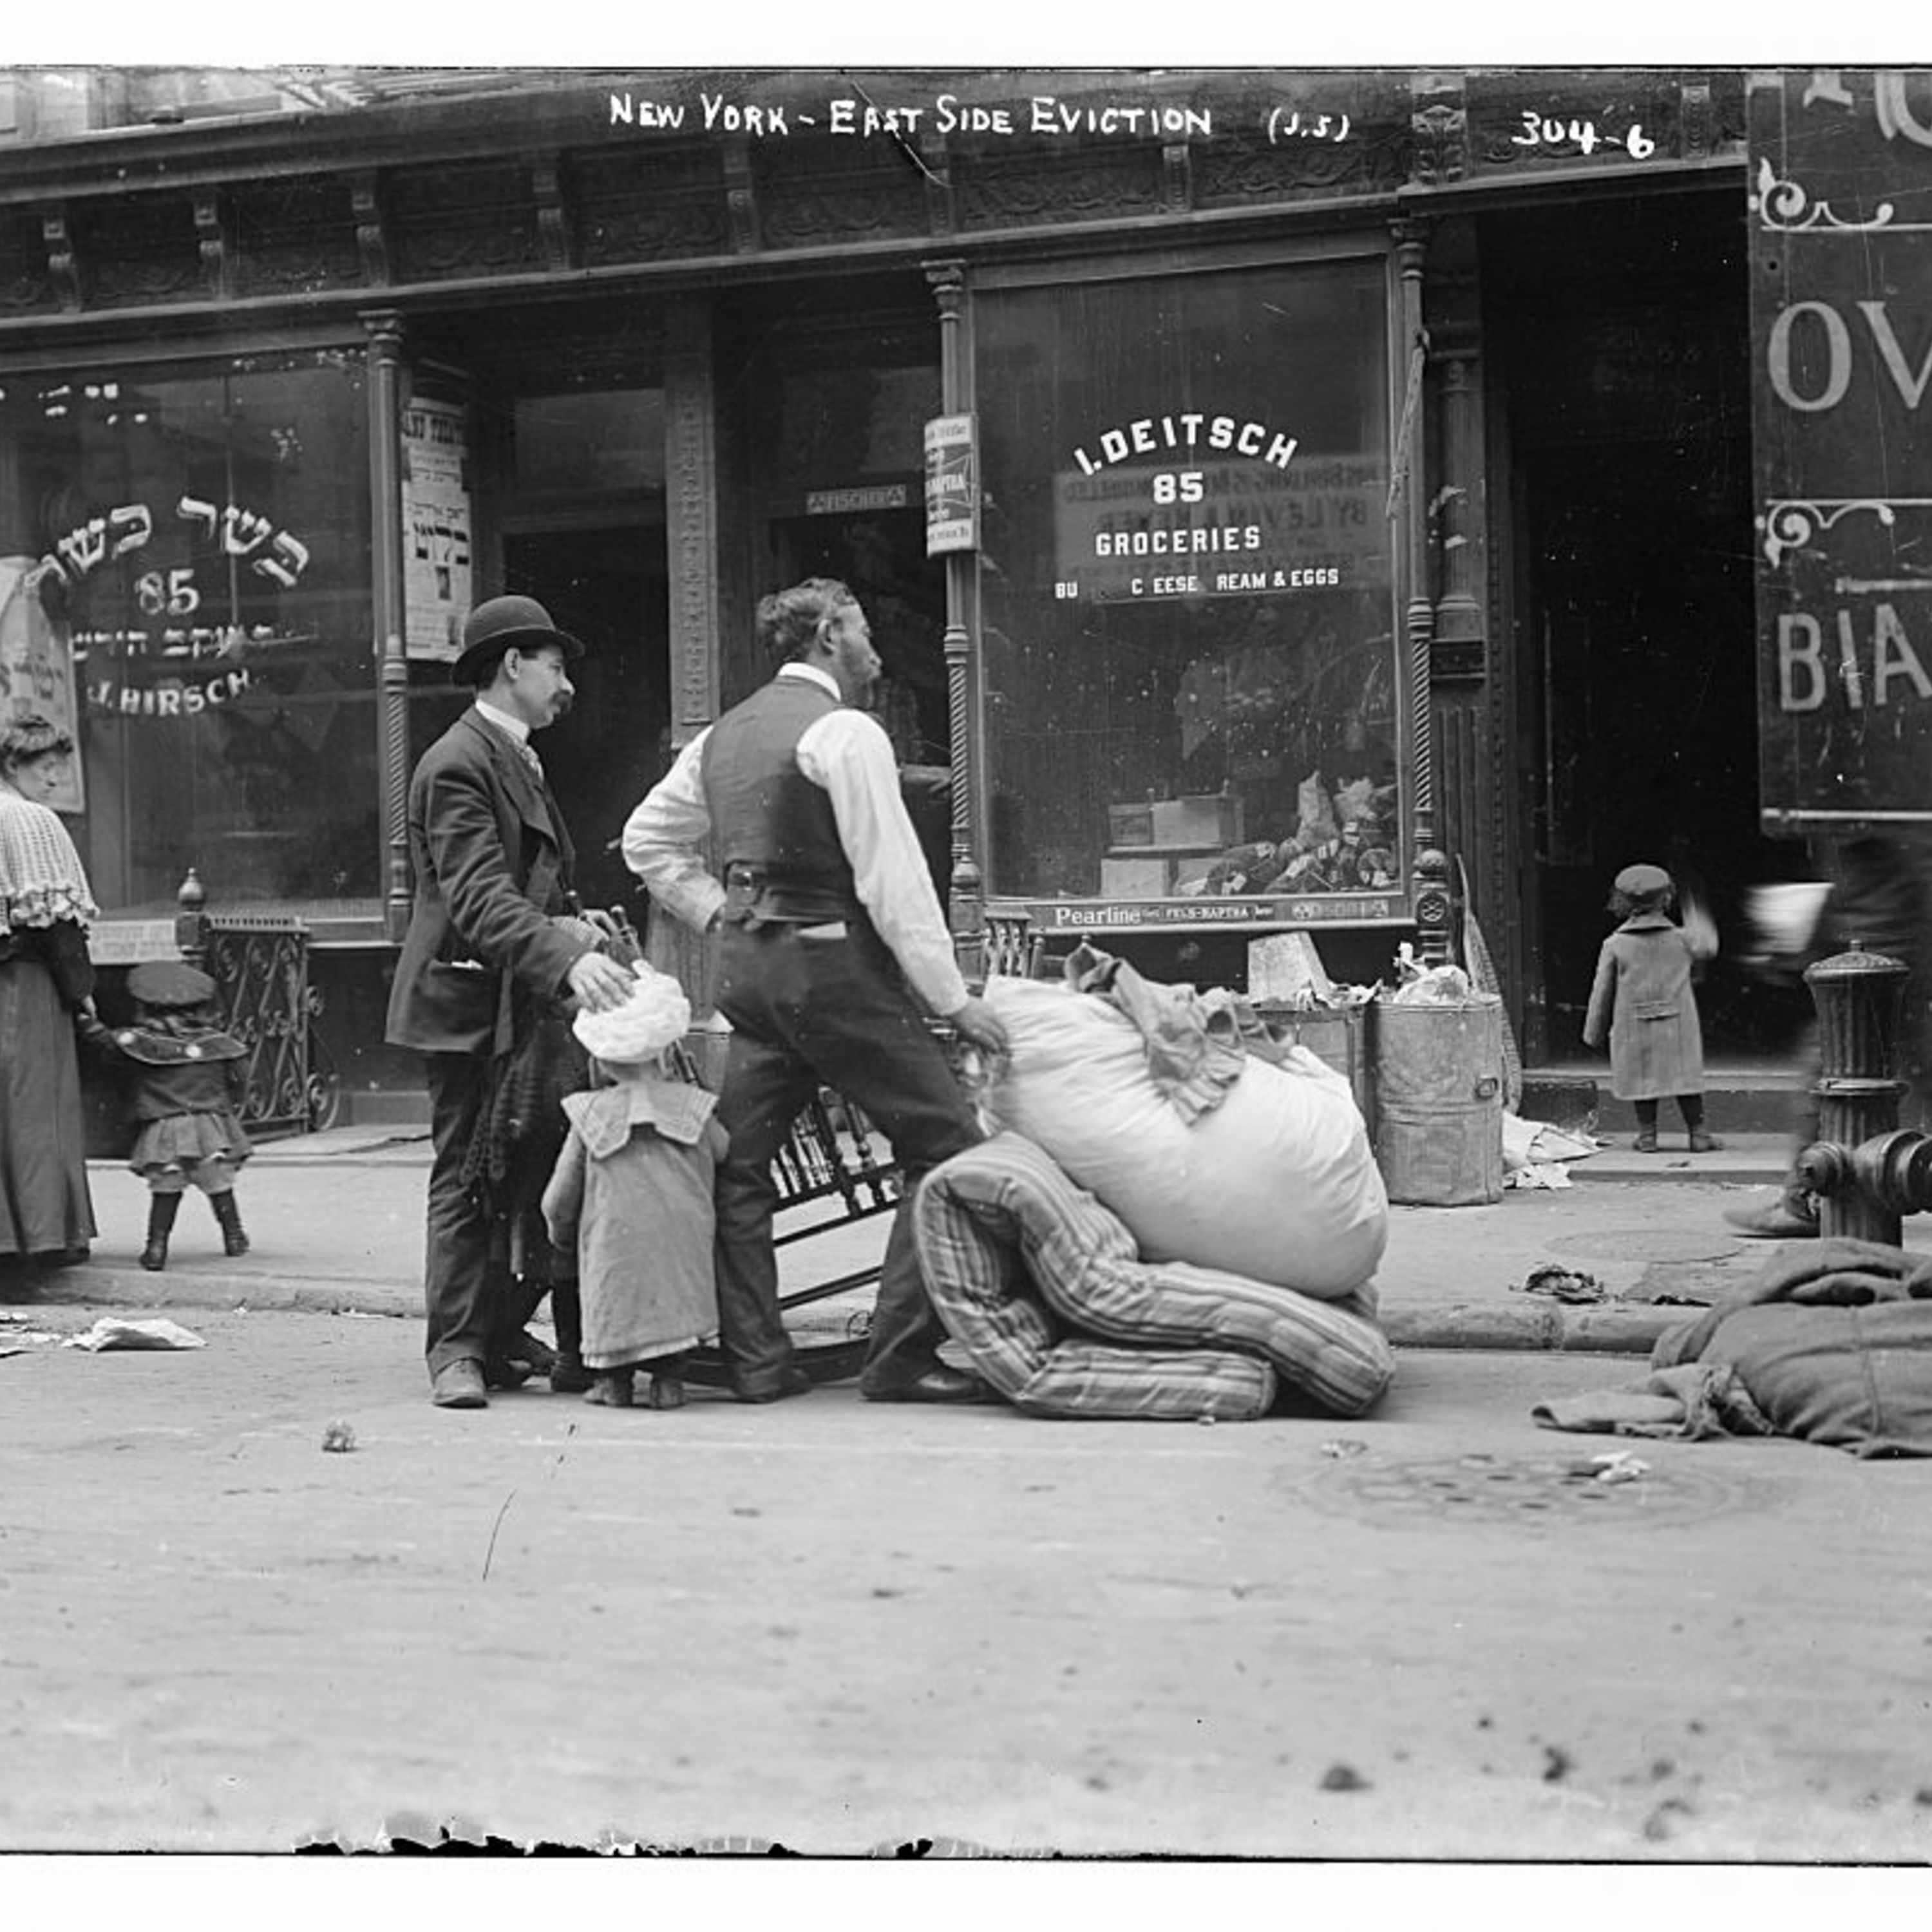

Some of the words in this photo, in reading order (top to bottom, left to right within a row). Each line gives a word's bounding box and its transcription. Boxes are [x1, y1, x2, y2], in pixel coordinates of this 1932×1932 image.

[1153, 471, 1203, 504] 85
[1095, 526, 1260, 556] GROCERIES
[137, 569, 200, 615] 85
[1273, 571, 1287, 587] &
[1291, 568, 1339, 587] EGGS
[1055, 905, 1142, 927] Pearline
